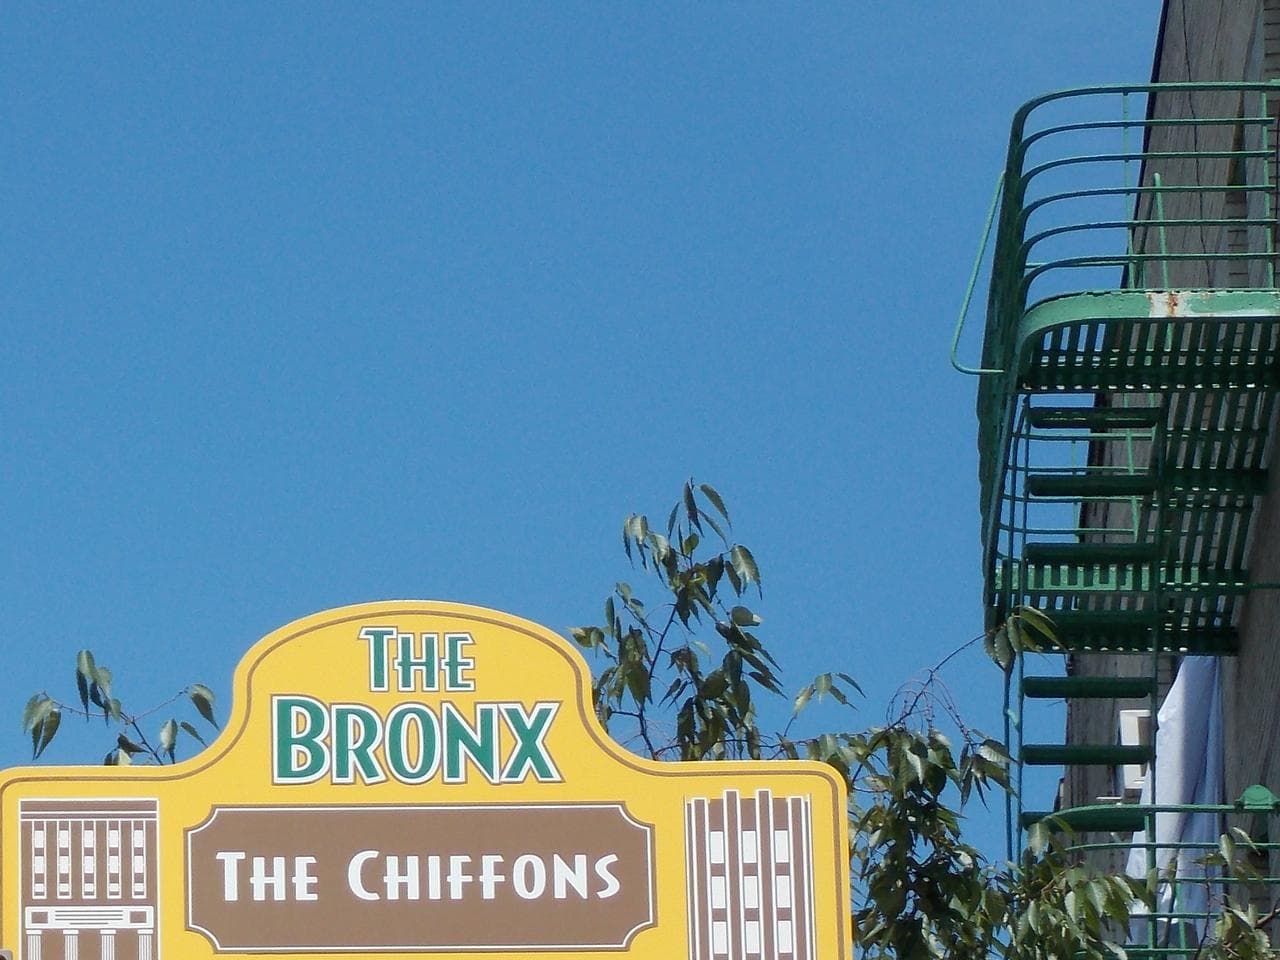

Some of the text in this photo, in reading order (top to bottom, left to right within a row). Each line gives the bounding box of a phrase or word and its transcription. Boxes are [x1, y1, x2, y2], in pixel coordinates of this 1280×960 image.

[359, 626, 477, 693] THE
[270, 693, 564, 787] BRONX
[216, 850, 621, 901] THE CHIFFONS
